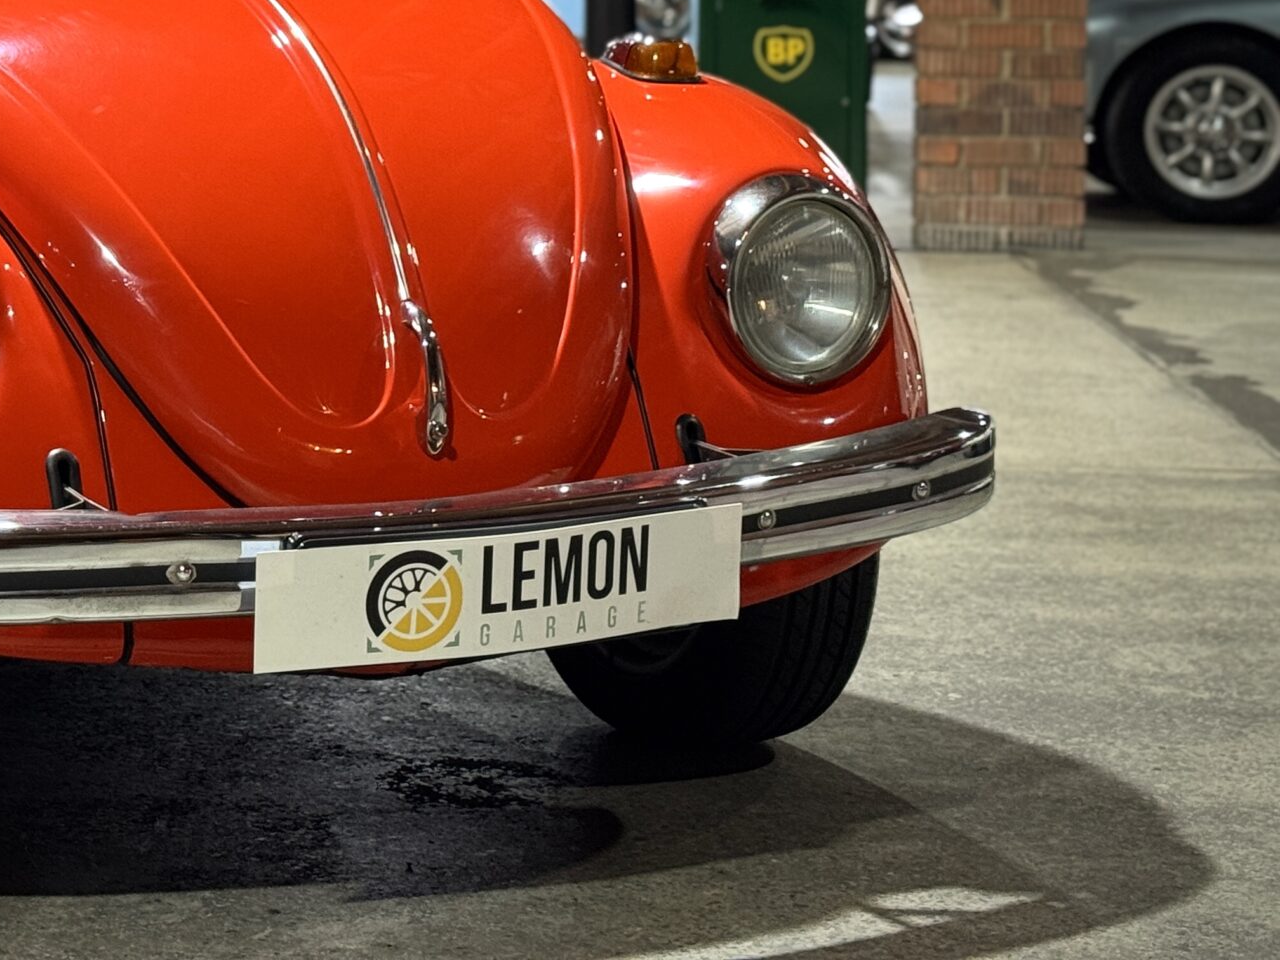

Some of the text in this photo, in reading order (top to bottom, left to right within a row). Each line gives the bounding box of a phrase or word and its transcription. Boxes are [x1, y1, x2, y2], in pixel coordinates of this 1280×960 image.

[766, 36, 806, 66] BP
[481, 524, 650, 615] LEMON
[480, 600, 647, 647] GARAGE
